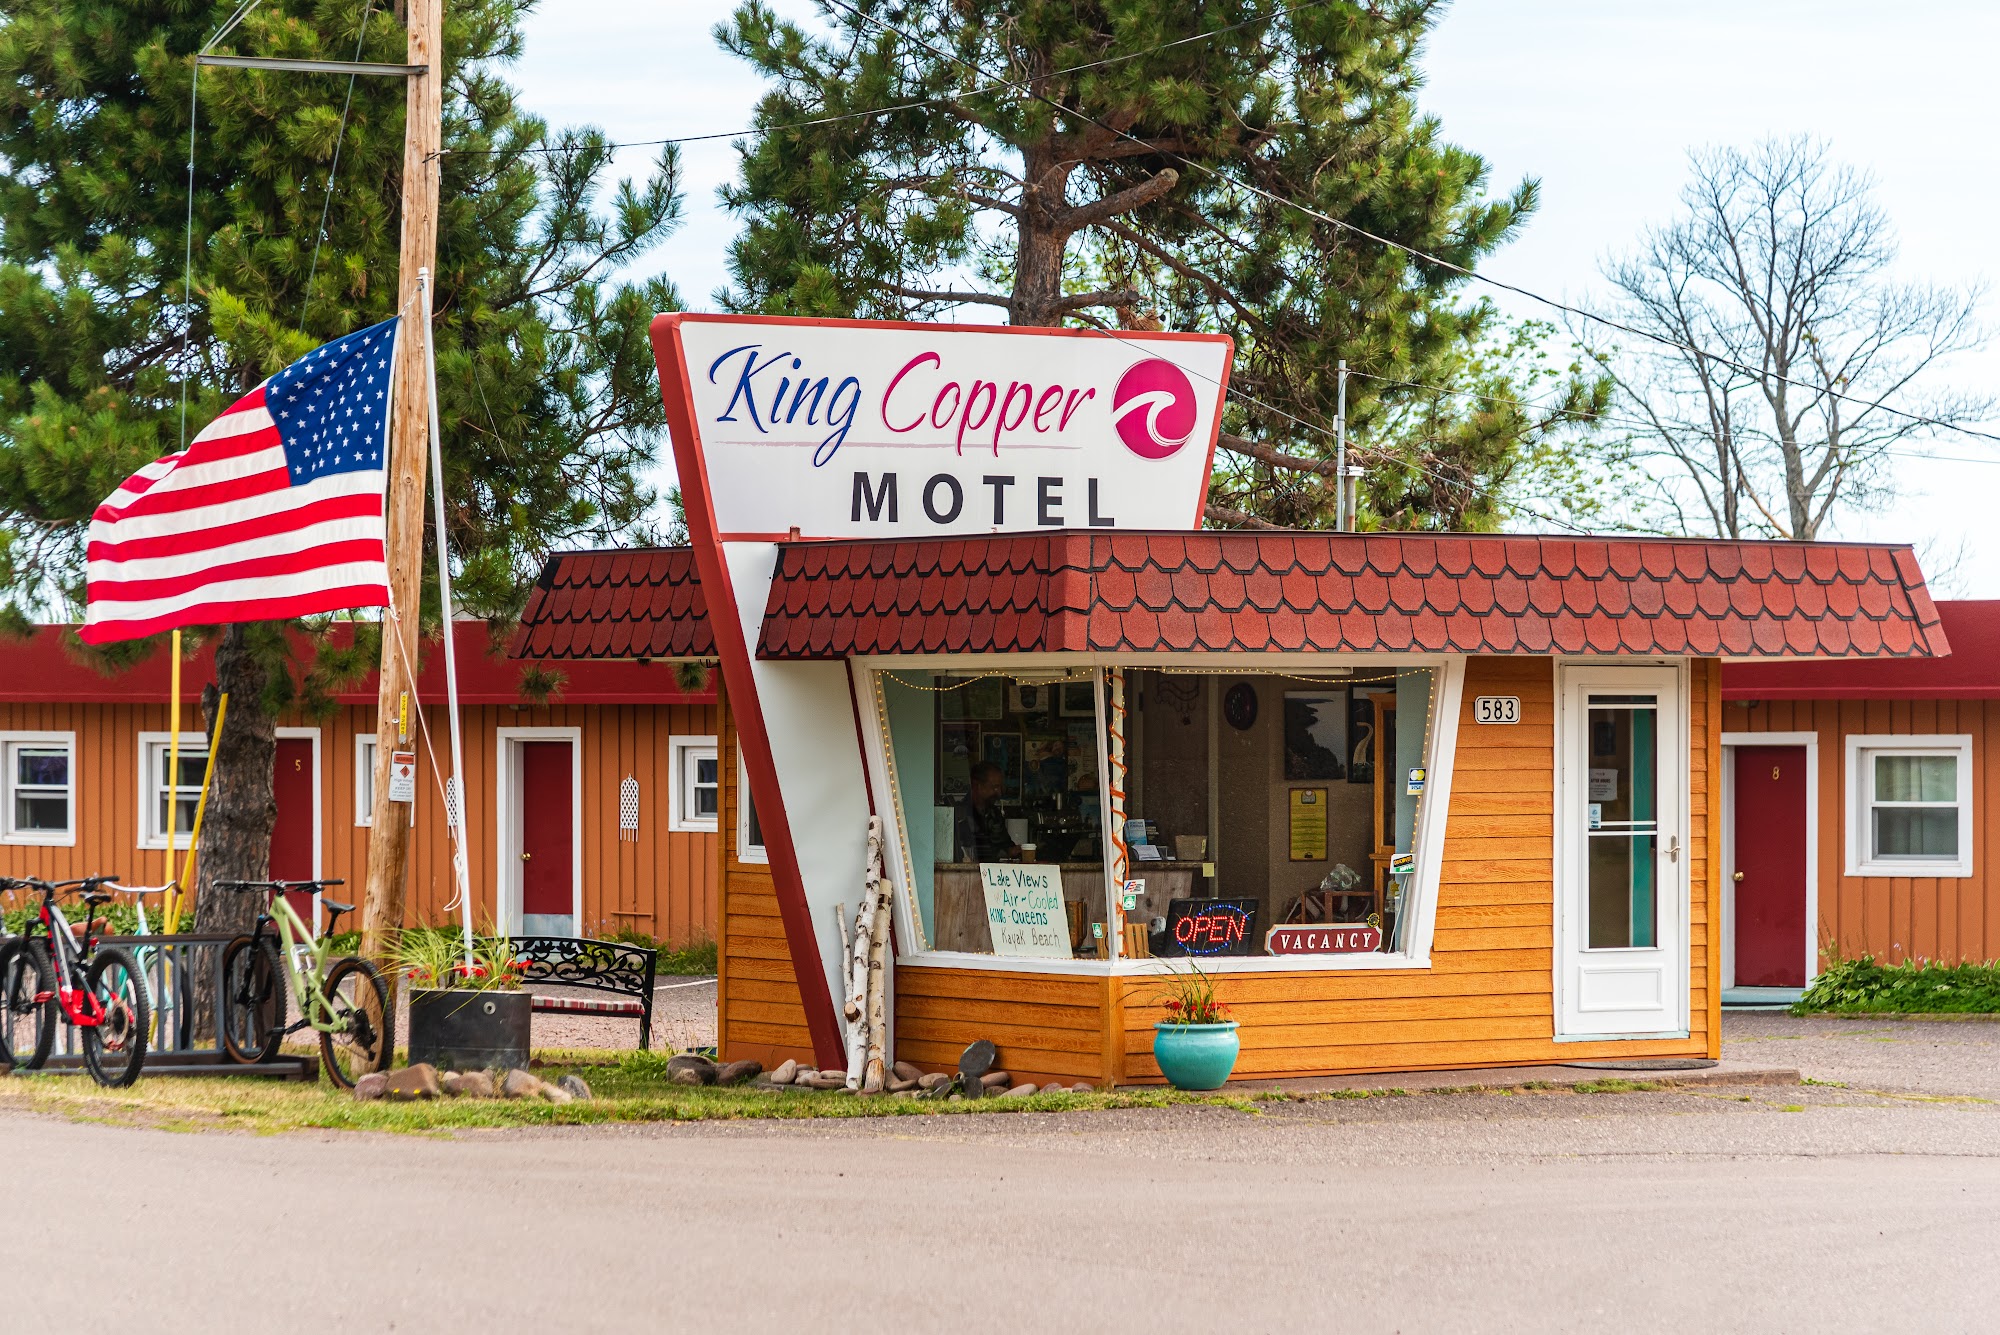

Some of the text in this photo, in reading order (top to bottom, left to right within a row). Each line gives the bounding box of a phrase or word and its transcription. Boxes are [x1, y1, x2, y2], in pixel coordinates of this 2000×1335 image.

[708, 344, 1096, 467] King Copper
[850, 471, 1115, 527] MOTEL
[1482, 699, 1514, 720] 583
[295, 759, 301, 771] 5
[1773, 766, 1780, 780] 8
[988, 868, 1011, 888] Lake
[1012, 869, 1049, 889] Views
[1031, 927, 1061, 948] Beach
[1175, 915, 1246, 942] OPEN
[1280, 932, 1372, 950] VACANCY
